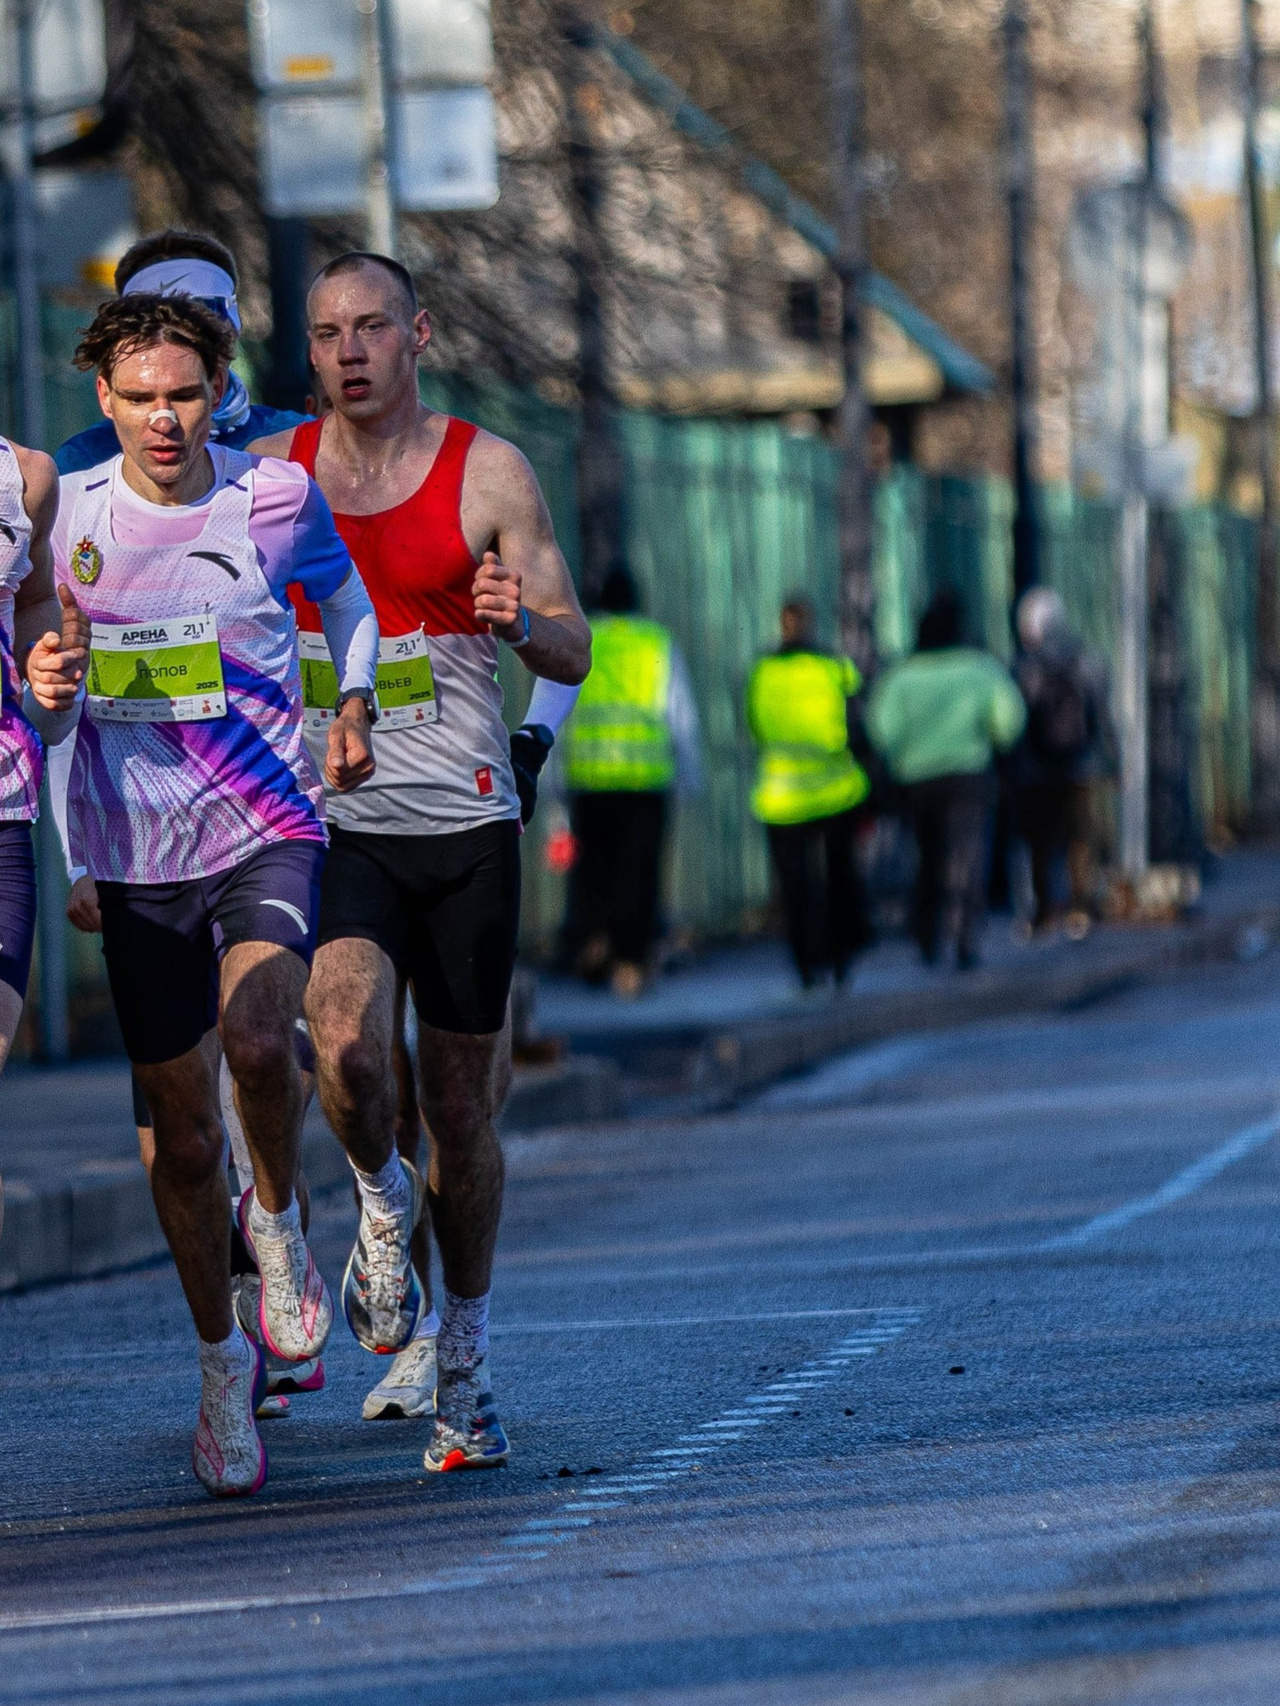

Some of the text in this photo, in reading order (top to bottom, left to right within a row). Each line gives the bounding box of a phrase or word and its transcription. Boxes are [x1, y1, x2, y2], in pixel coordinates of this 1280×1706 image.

[121, 628, 167, 641] АРЕНА
[183, 622, 204, 636] 21,1
[396, 640, 417, 654] 21,1
[140, 665, 188, 679] ПОПОВ
[196, 681, 219, 690] 2025
[409, 691, 432, 700] 2025
